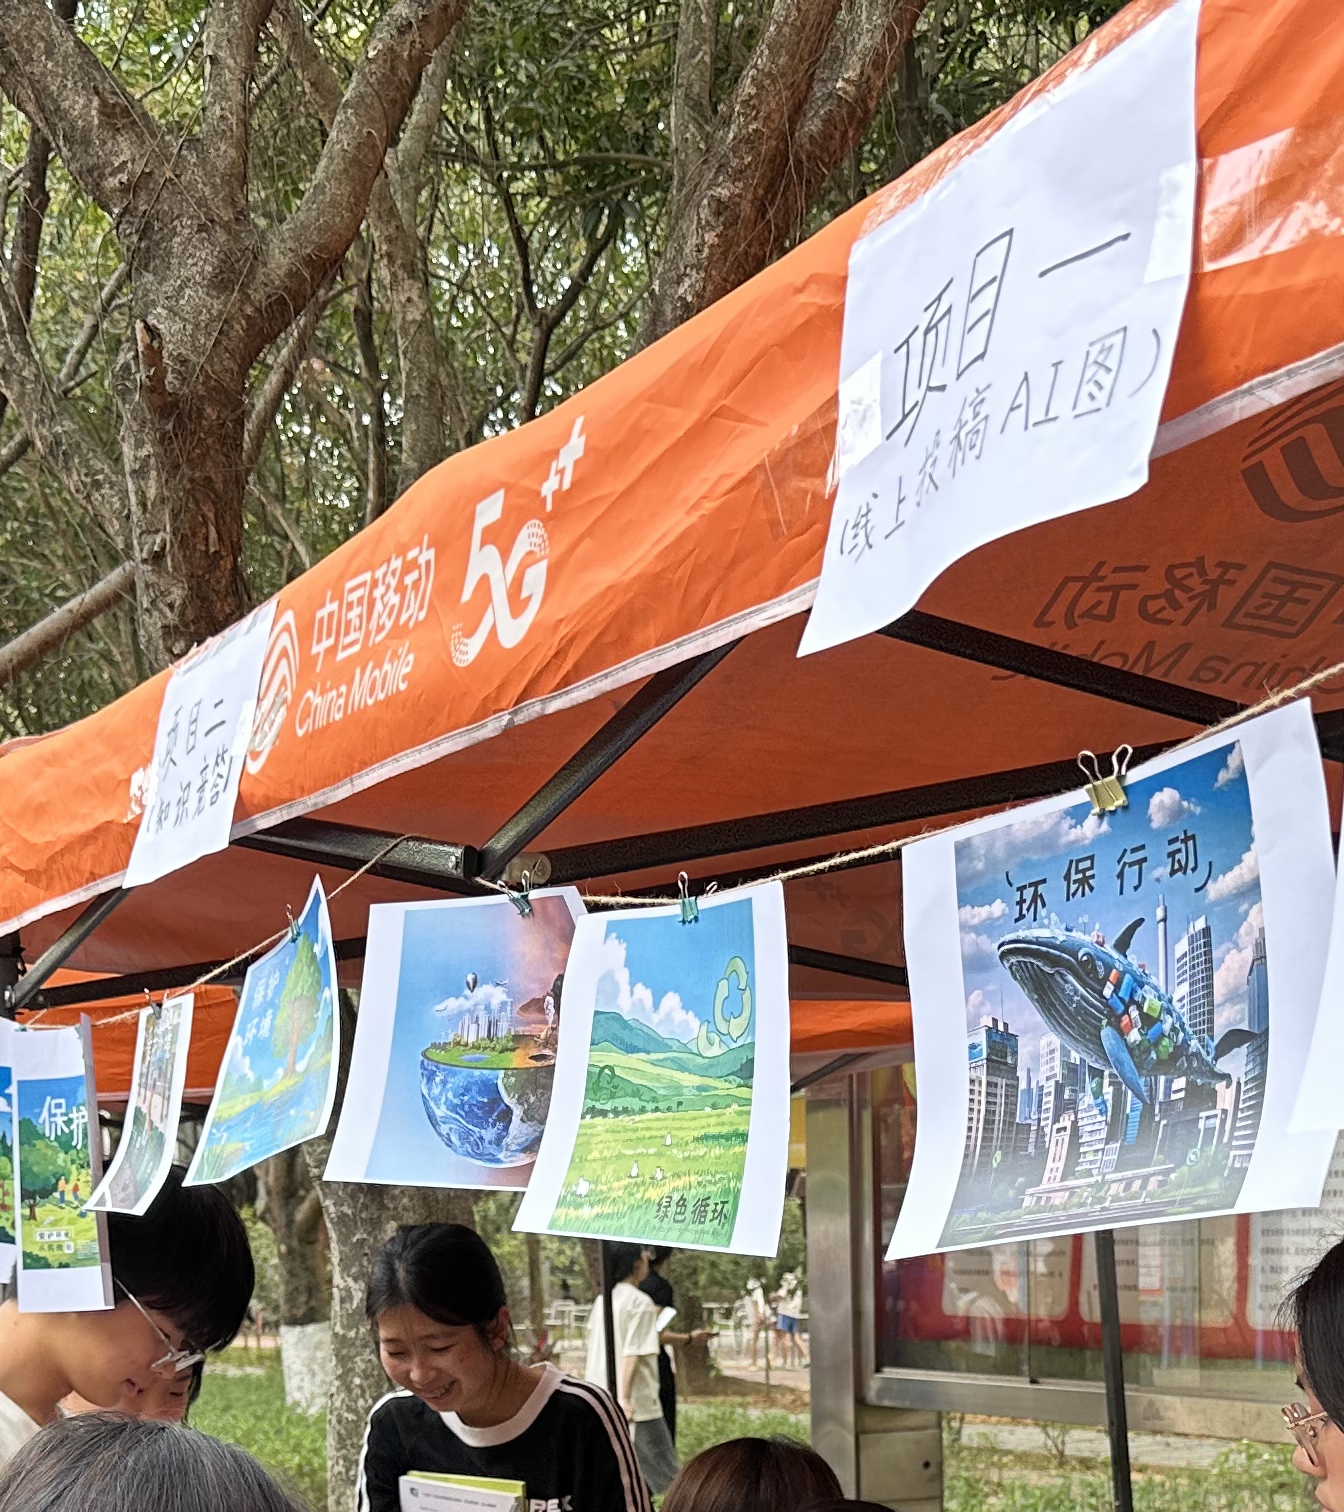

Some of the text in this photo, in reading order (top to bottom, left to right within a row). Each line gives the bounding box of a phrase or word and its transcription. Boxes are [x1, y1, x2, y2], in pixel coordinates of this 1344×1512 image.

[885, 227, 1131, 446] 项目一
[310, 533, 436, 675] 中国移动
[295, 648, 416, 738] China Mobile
[162, 698, 227, 782] 项目二
[1011, 829, 1204, 925] 环保行动
[38, 1095, 89, 1150] 保护
[653, 1193, 730, 1230] 绿色循环
